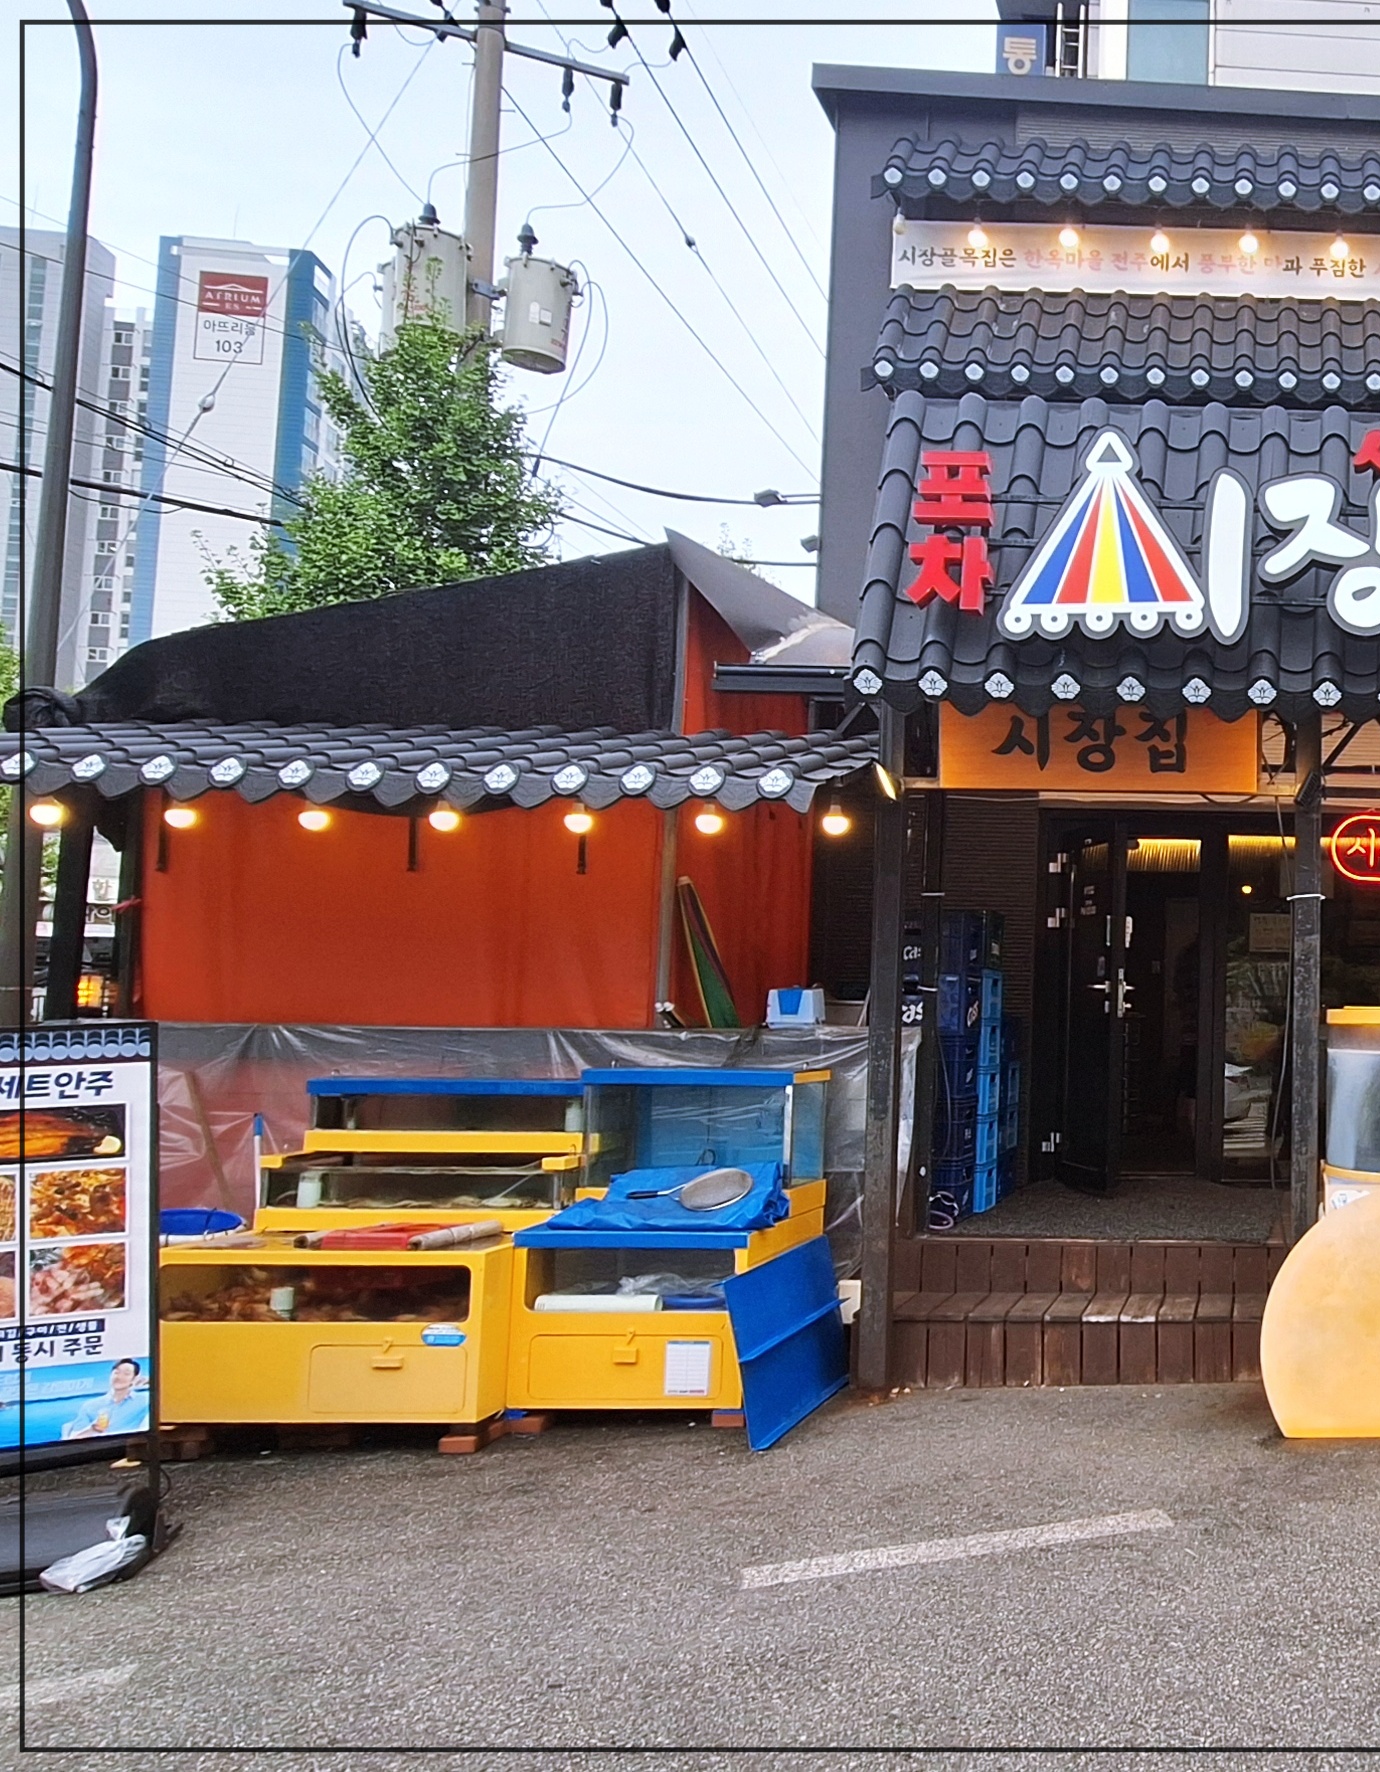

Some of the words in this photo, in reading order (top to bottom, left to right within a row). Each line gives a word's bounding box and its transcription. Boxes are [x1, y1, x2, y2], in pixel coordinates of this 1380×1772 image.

[898, 246, 1017, 269] 시장골목집은
[1023, 248, 1104, 271] 한옥마을
[1111, 250, 1190, 273] 전주에서
[1198, 253, 1257, 275] 풍부한
[1309, 257, 1367, 279] 푸짐한
[204, 291, 261, 304] ATRIUM
[215, 340, 243, 354] 103
[905, 450, 995, 616] 포차
[991, 707, 1188, 774] 시장집
[12, 1340, 55, 1363] 동시
[62, 1335, 104, 1357] 주문
